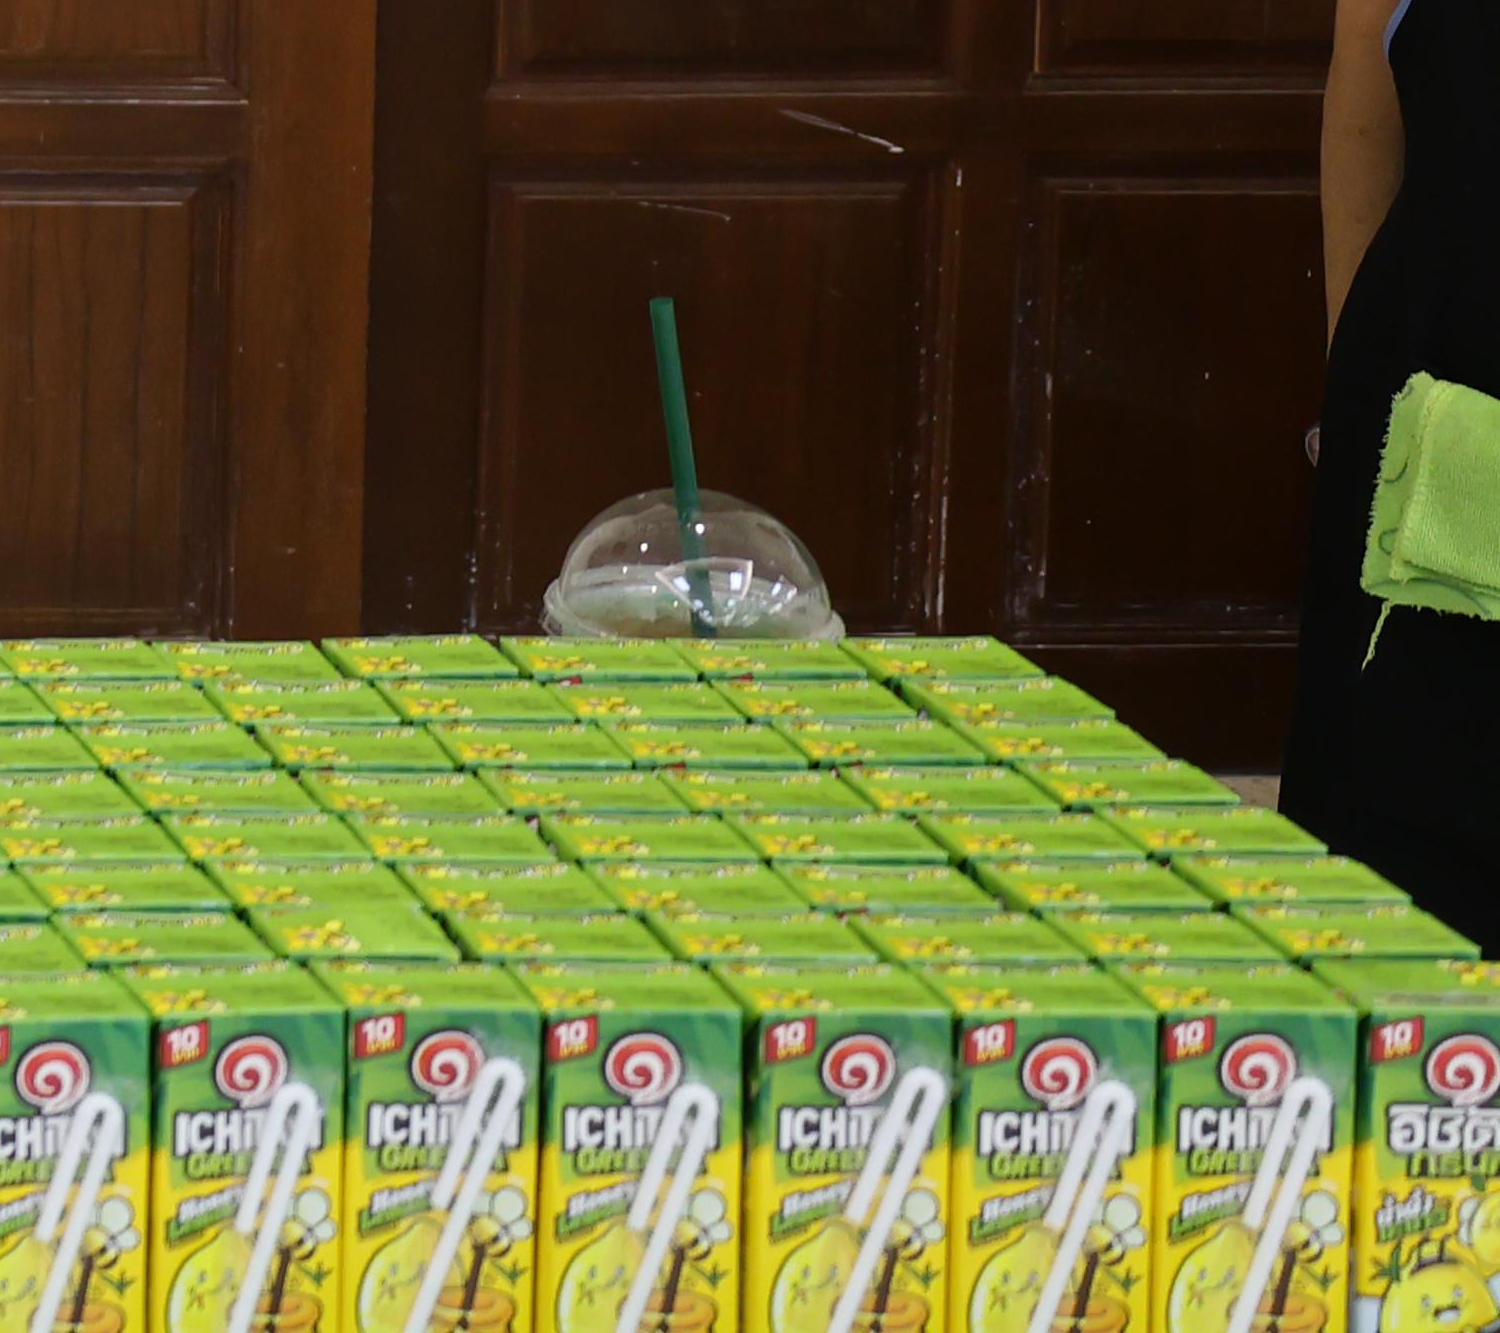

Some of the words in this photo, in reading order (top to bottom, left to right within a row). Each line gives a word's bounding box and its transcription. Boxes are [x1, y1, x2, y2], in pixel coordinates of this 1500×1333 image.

[167, 1024, 200, 1053] 10
[362, 1016, 397, 1043] 10
[554, 1019, 590, 1046] 10
[772, 1021, 808, 1047] 10
[972, 1023, 1007, 1051] 10
[1172, 1020, 1206, 1048] 10
[1380, 1020, 1413, 1049] 10
